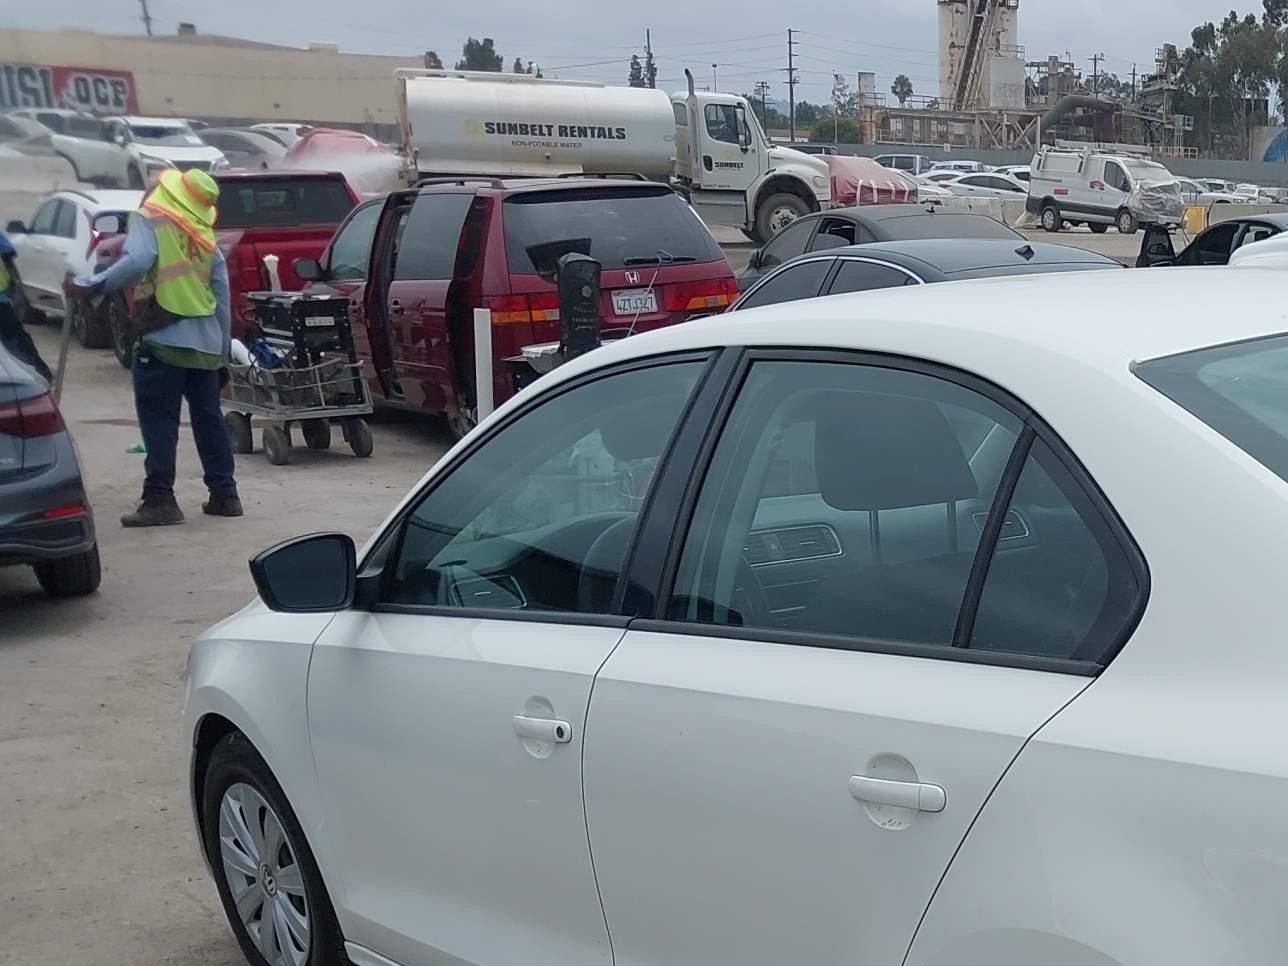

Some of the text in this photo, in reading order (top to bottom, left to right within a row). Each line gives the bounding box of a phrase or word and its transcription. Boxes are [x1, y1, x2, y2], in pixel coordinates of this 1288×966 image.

[484, 121, 626, 139] SUNBELT RENTALS
[511, 139, 559, 148] NON-POTABLE
